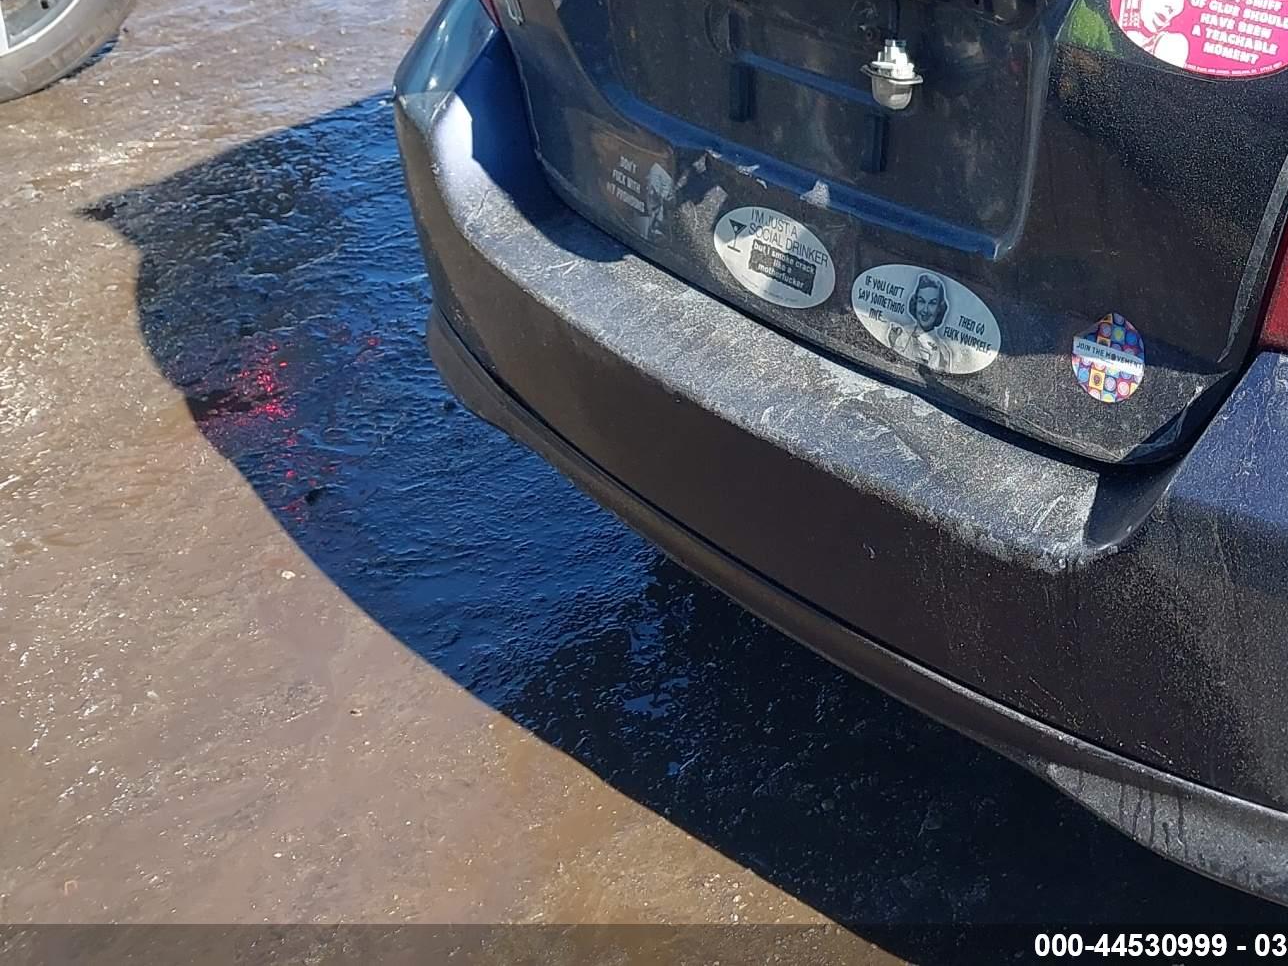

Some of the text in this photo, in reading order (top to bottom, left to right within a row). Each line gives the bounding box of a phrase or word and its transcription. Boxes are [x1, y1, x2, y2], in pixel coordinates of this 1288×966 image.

[1208, 0, 1240, 17] GLUE
[1200, 13, 1272, 39] HAVE BEEN
[1191, 24, 1279, 55] A TEACHABLE
[1202, 42, 1259, 64] MOMENT
[750, 209, 798, 238] I'M JUST A
[748, 223, 829, 267] SOCIAL DRINKER
[753, 242, 766, 254] but
[771, 250, 795, 265] smoke
[795, 260, 815, 274] crack
[757, 263, 805, 289] motherfucker
[773, 259, 786, 271] like
[865, 275, 905, 299] IF YOU CAN'T
[858, 288, 905, 315] SAY SOMETHING
[943, 326, 959, 341] FUCK
[958, 315, 985, 336] THEN GO
[1075, 341, 1143, 369] JOIN THE MOVEMENT
